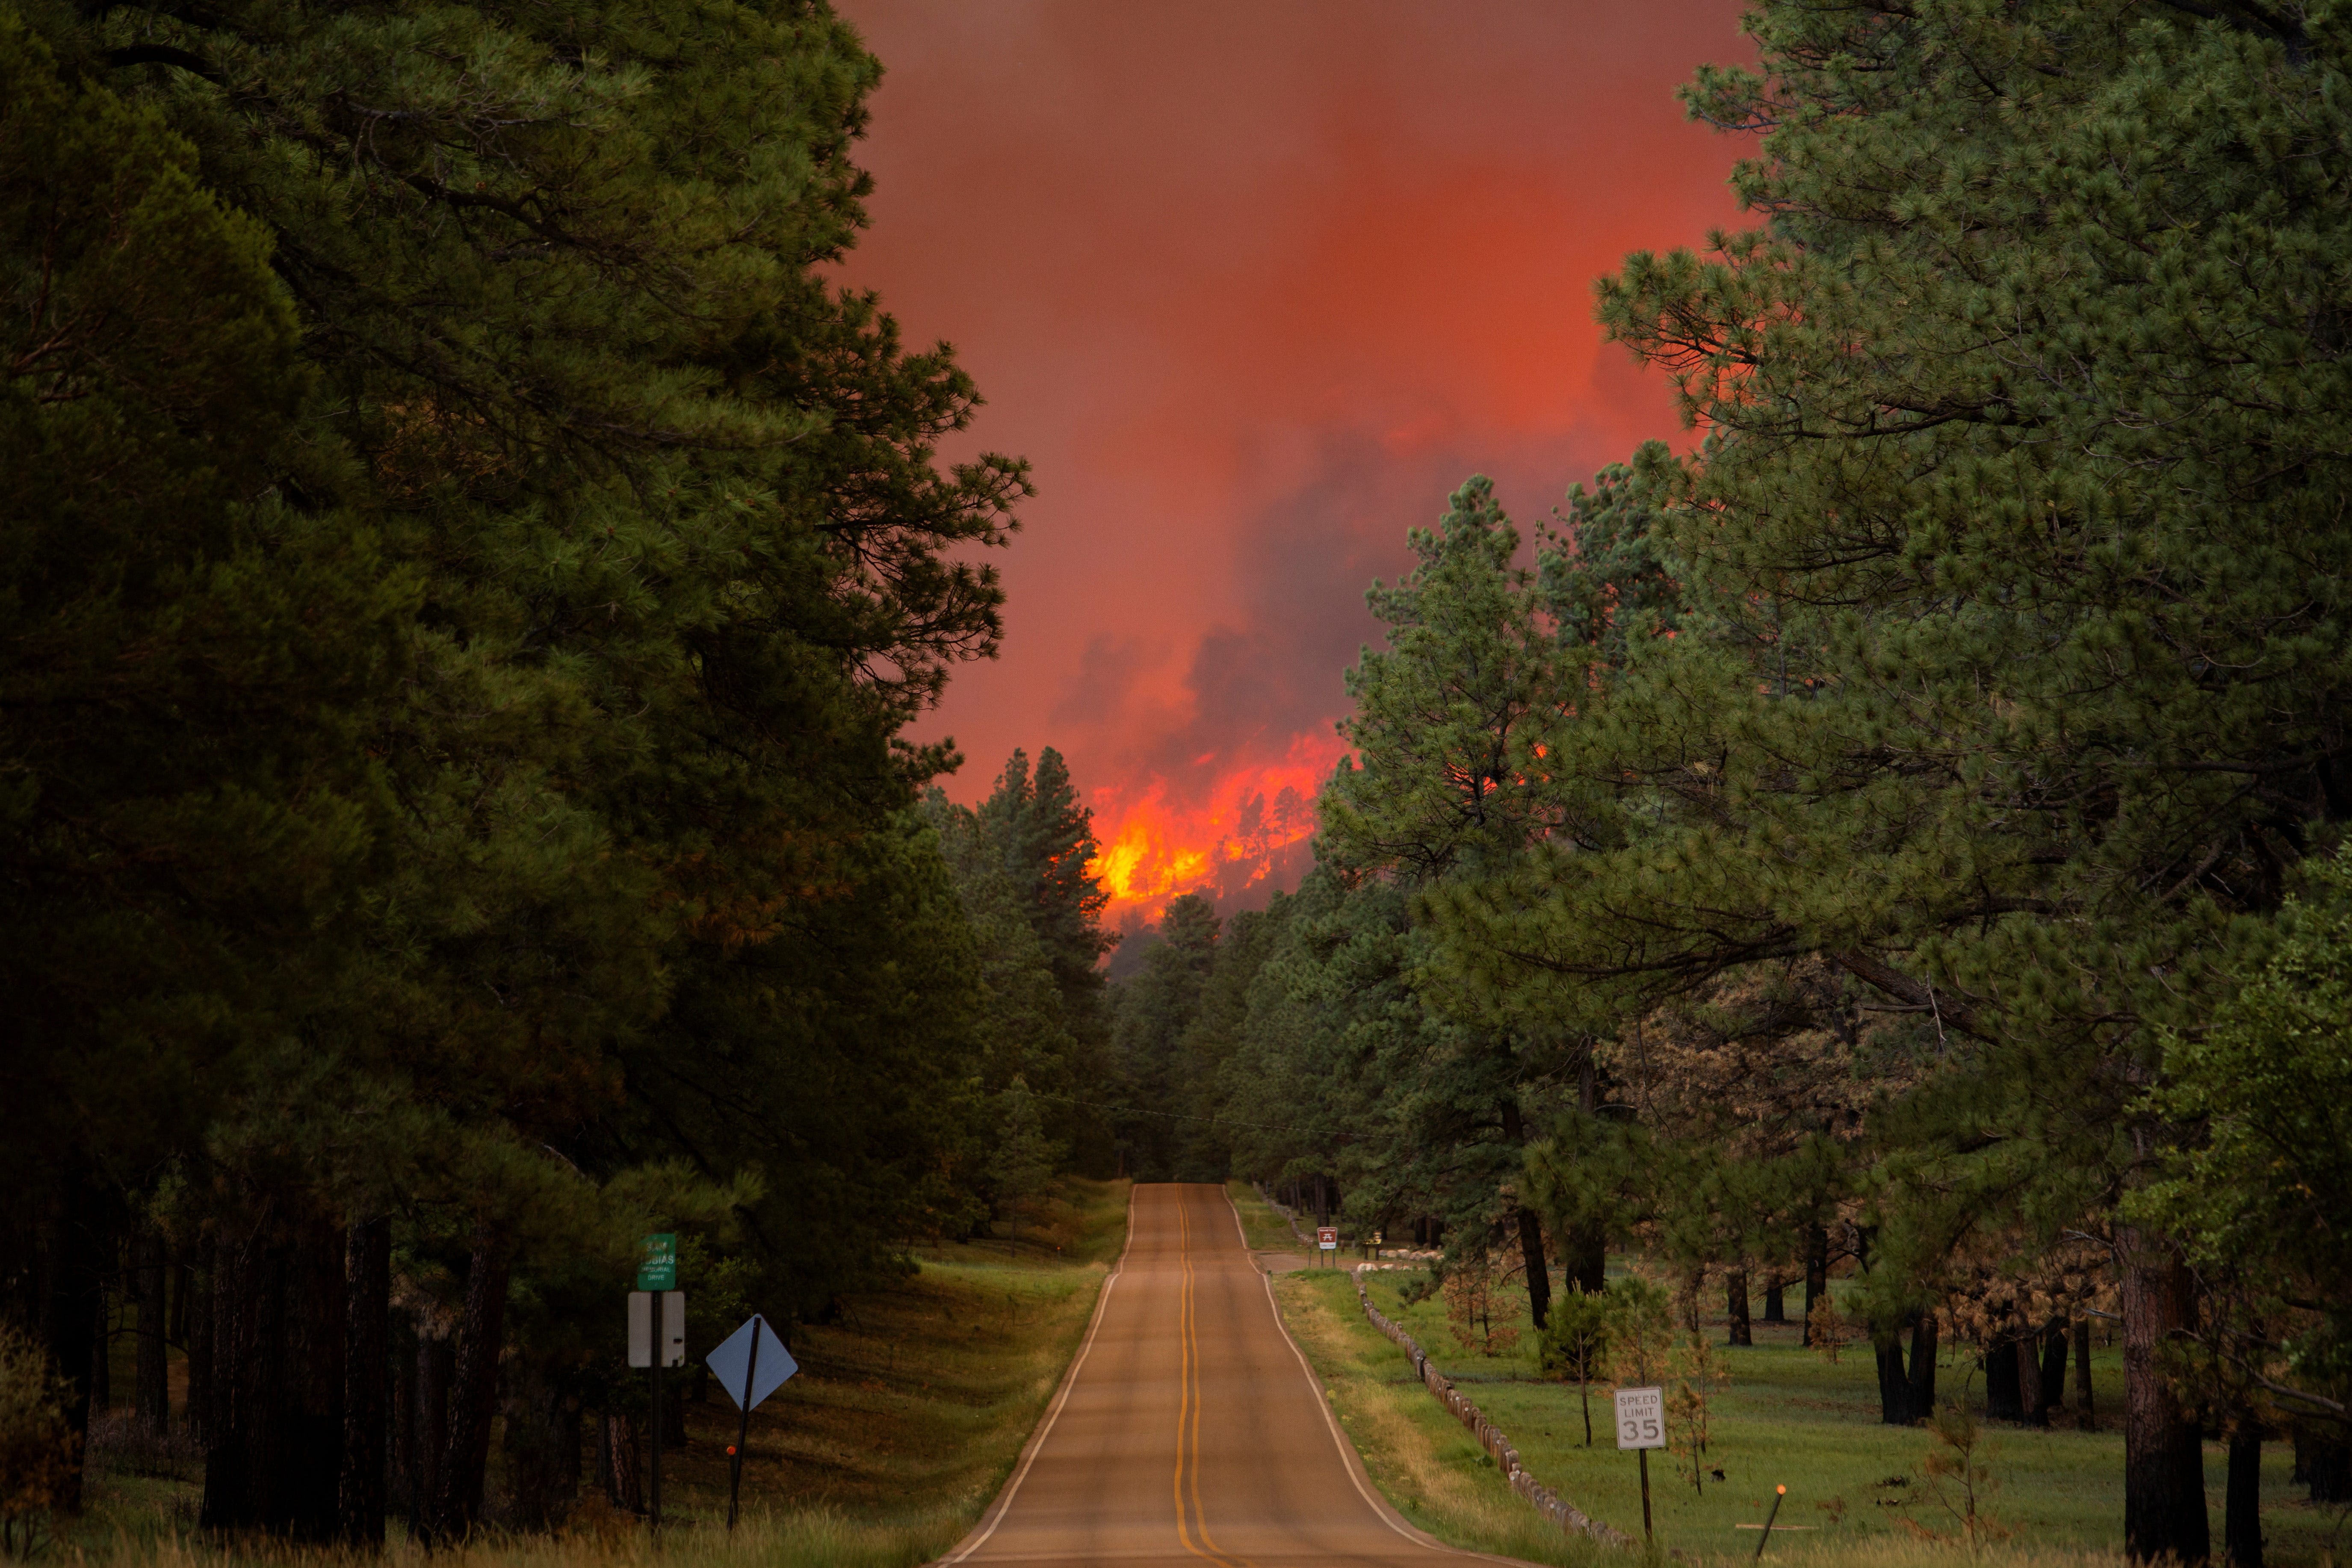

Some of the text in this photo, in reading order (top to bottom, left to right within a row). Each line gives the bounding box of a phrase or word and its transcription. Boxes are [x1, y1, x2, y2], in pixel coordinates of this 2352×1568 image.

[640, 1255, 674, 1264] BIAS
[1620, 1396, 1658, 1406] SPEED
[1625, 1408, 1654, 1417] LIMIT
[1623, 1419, 1659, 1441] 35
